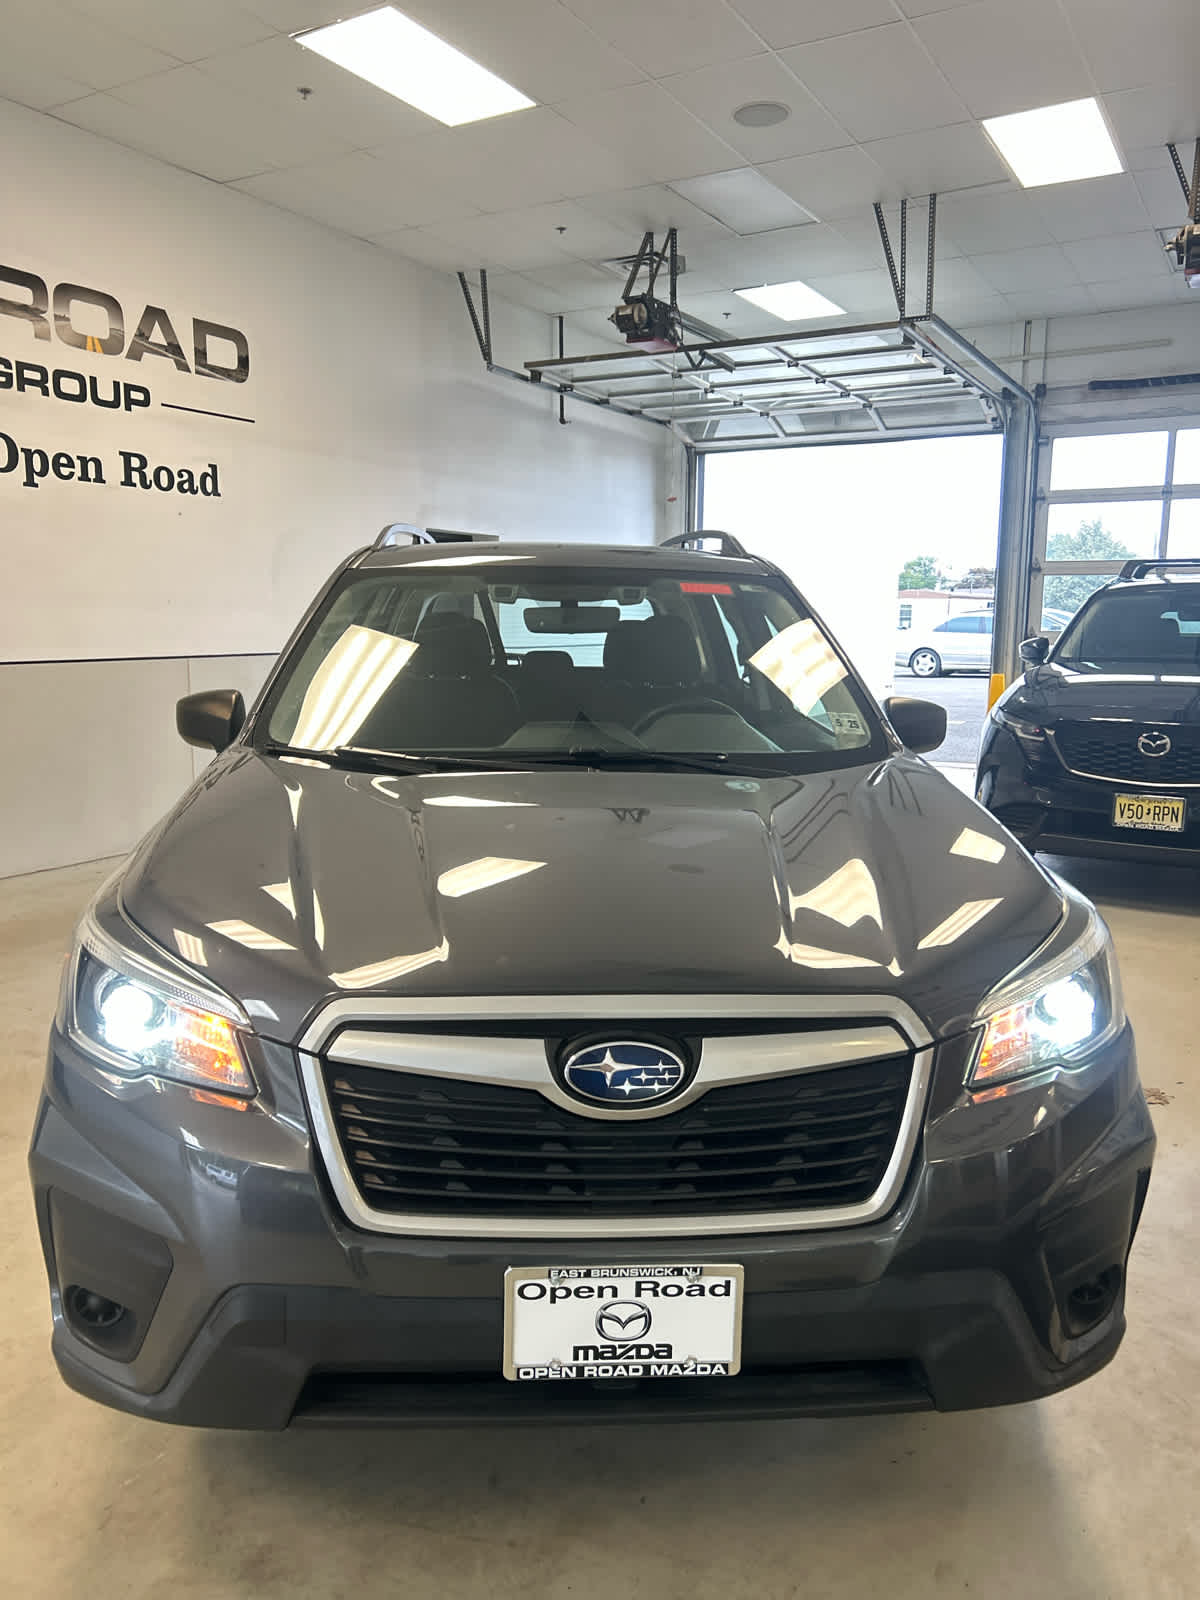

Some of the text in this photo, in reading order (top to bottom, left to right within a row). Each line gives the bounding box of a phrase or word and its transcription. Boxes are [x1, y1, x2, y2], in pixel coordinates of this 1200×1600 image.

[0, 264, 250, 384] ROAD
[118, 450, 222, 497] Road
[550, 1269, 587, 1279] EAST
[682, 1266, 701, 1276] NJ
[517, 1280, 731, 1304] Open Road
[518, 1363, 727, 1380] OPEN ROAD MAZDA
